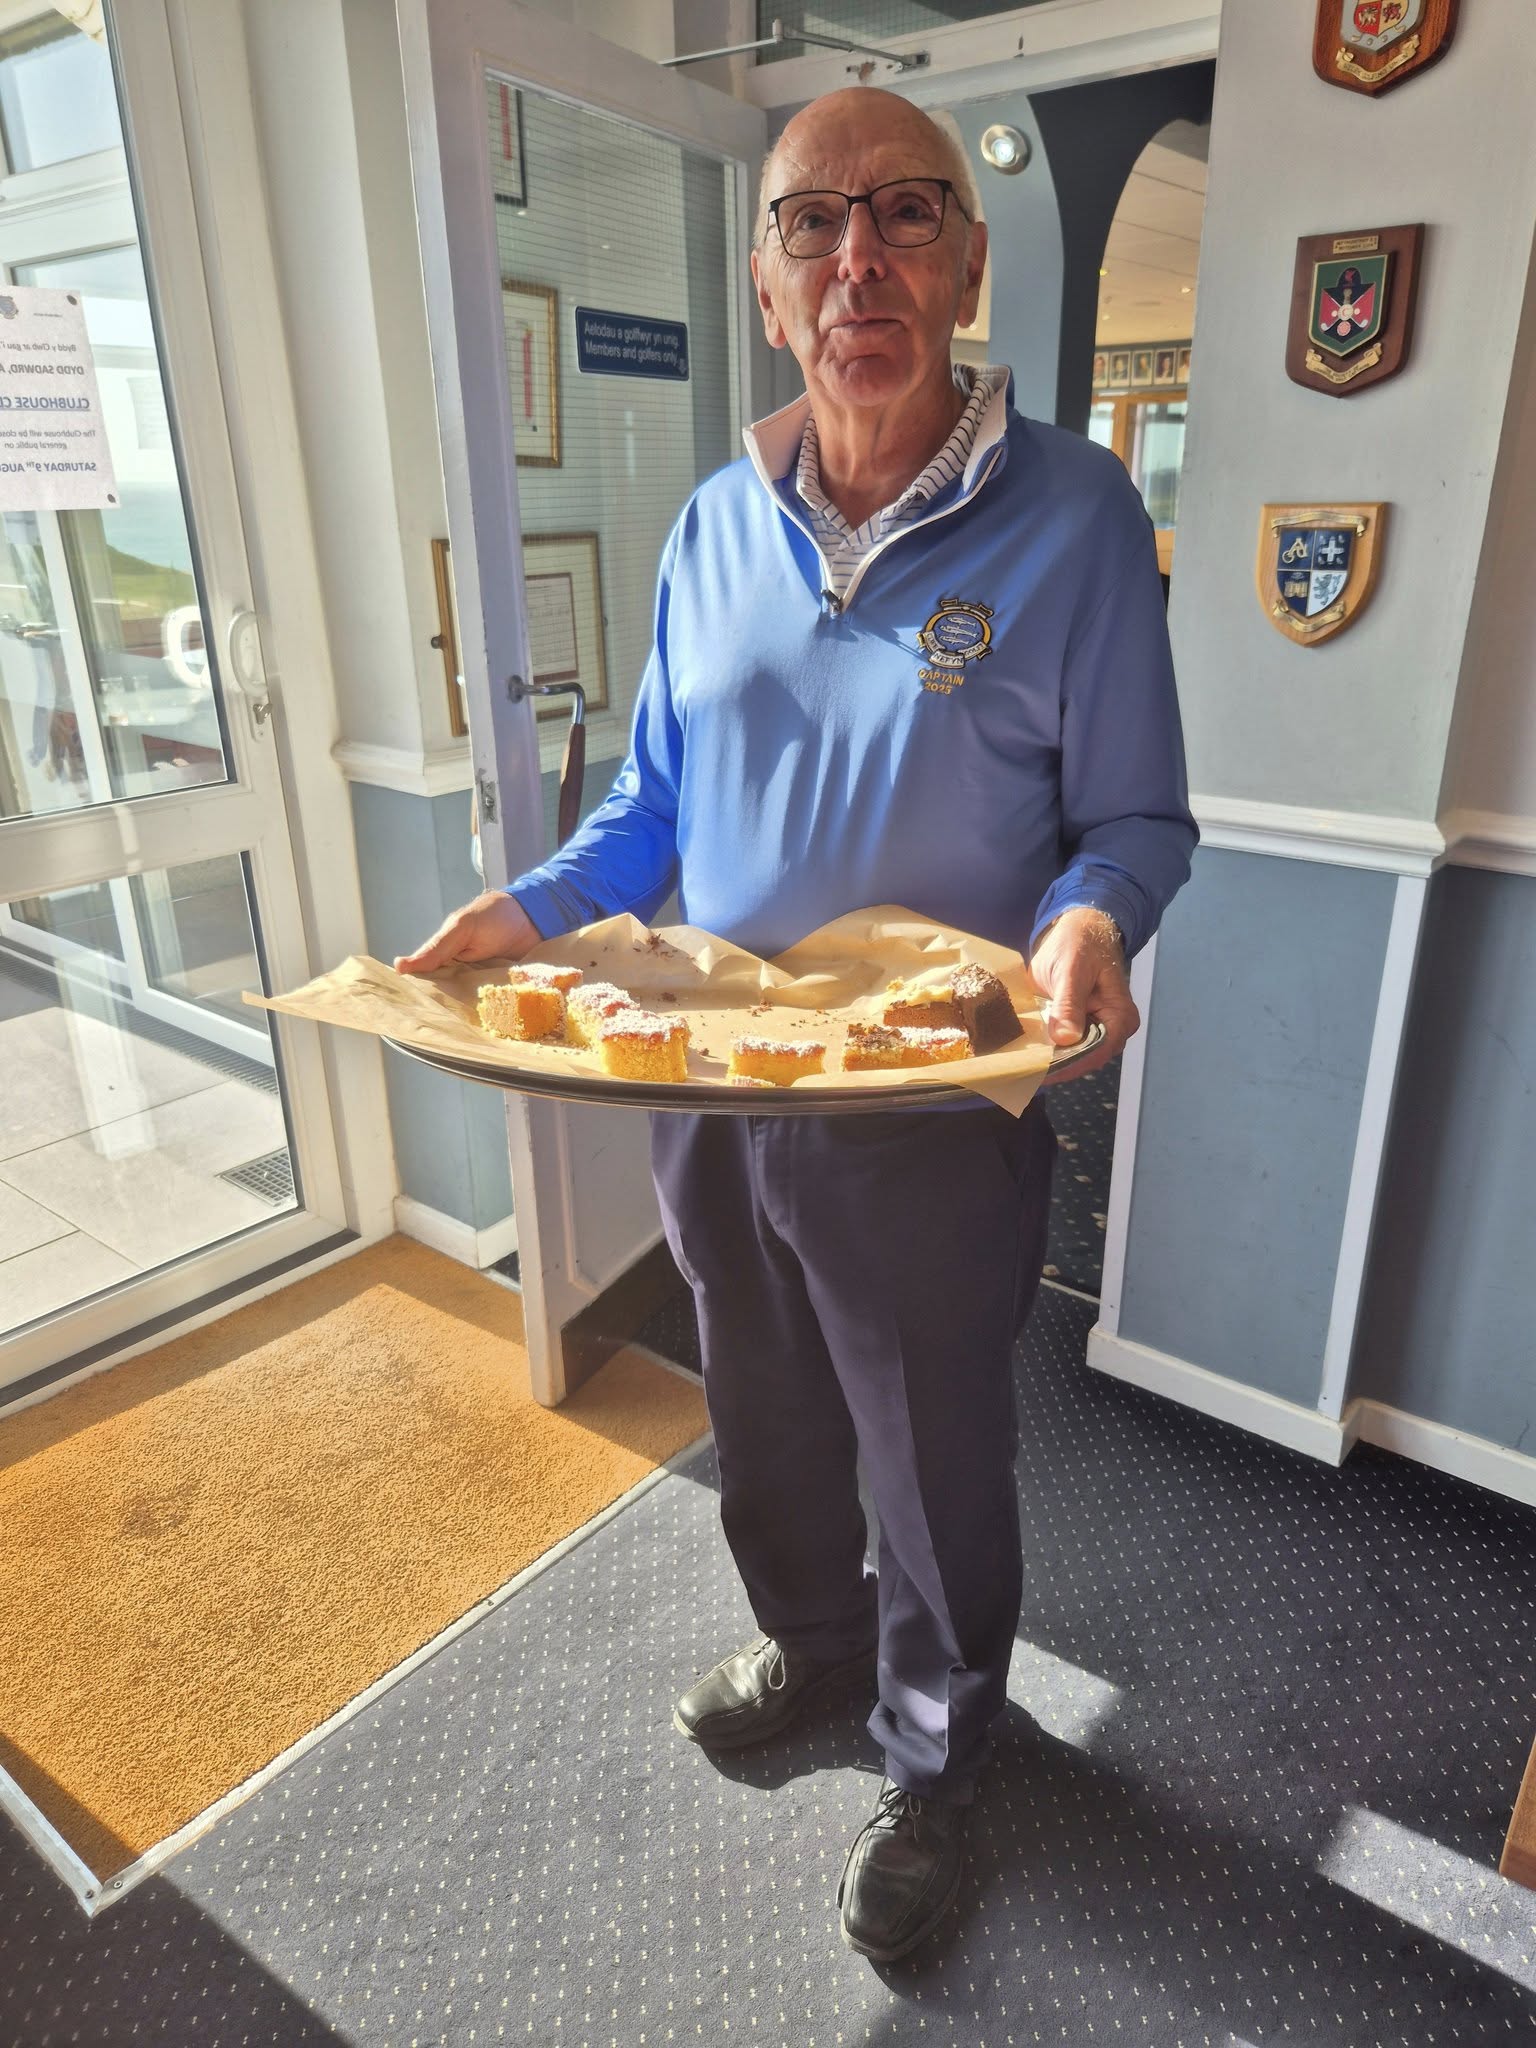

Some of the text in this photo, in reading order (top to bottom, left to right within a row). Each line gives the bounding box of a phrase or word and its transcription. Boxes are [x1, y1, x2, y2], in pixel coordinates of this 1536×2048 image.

[585, 341, 621, 358] Members
[622, 346, 637, 359] and
[934, 653, 963, 664] NEFYN
[918, 669, 965, 686] CAPTAIN
[924, 681, 953, 695] 2025
